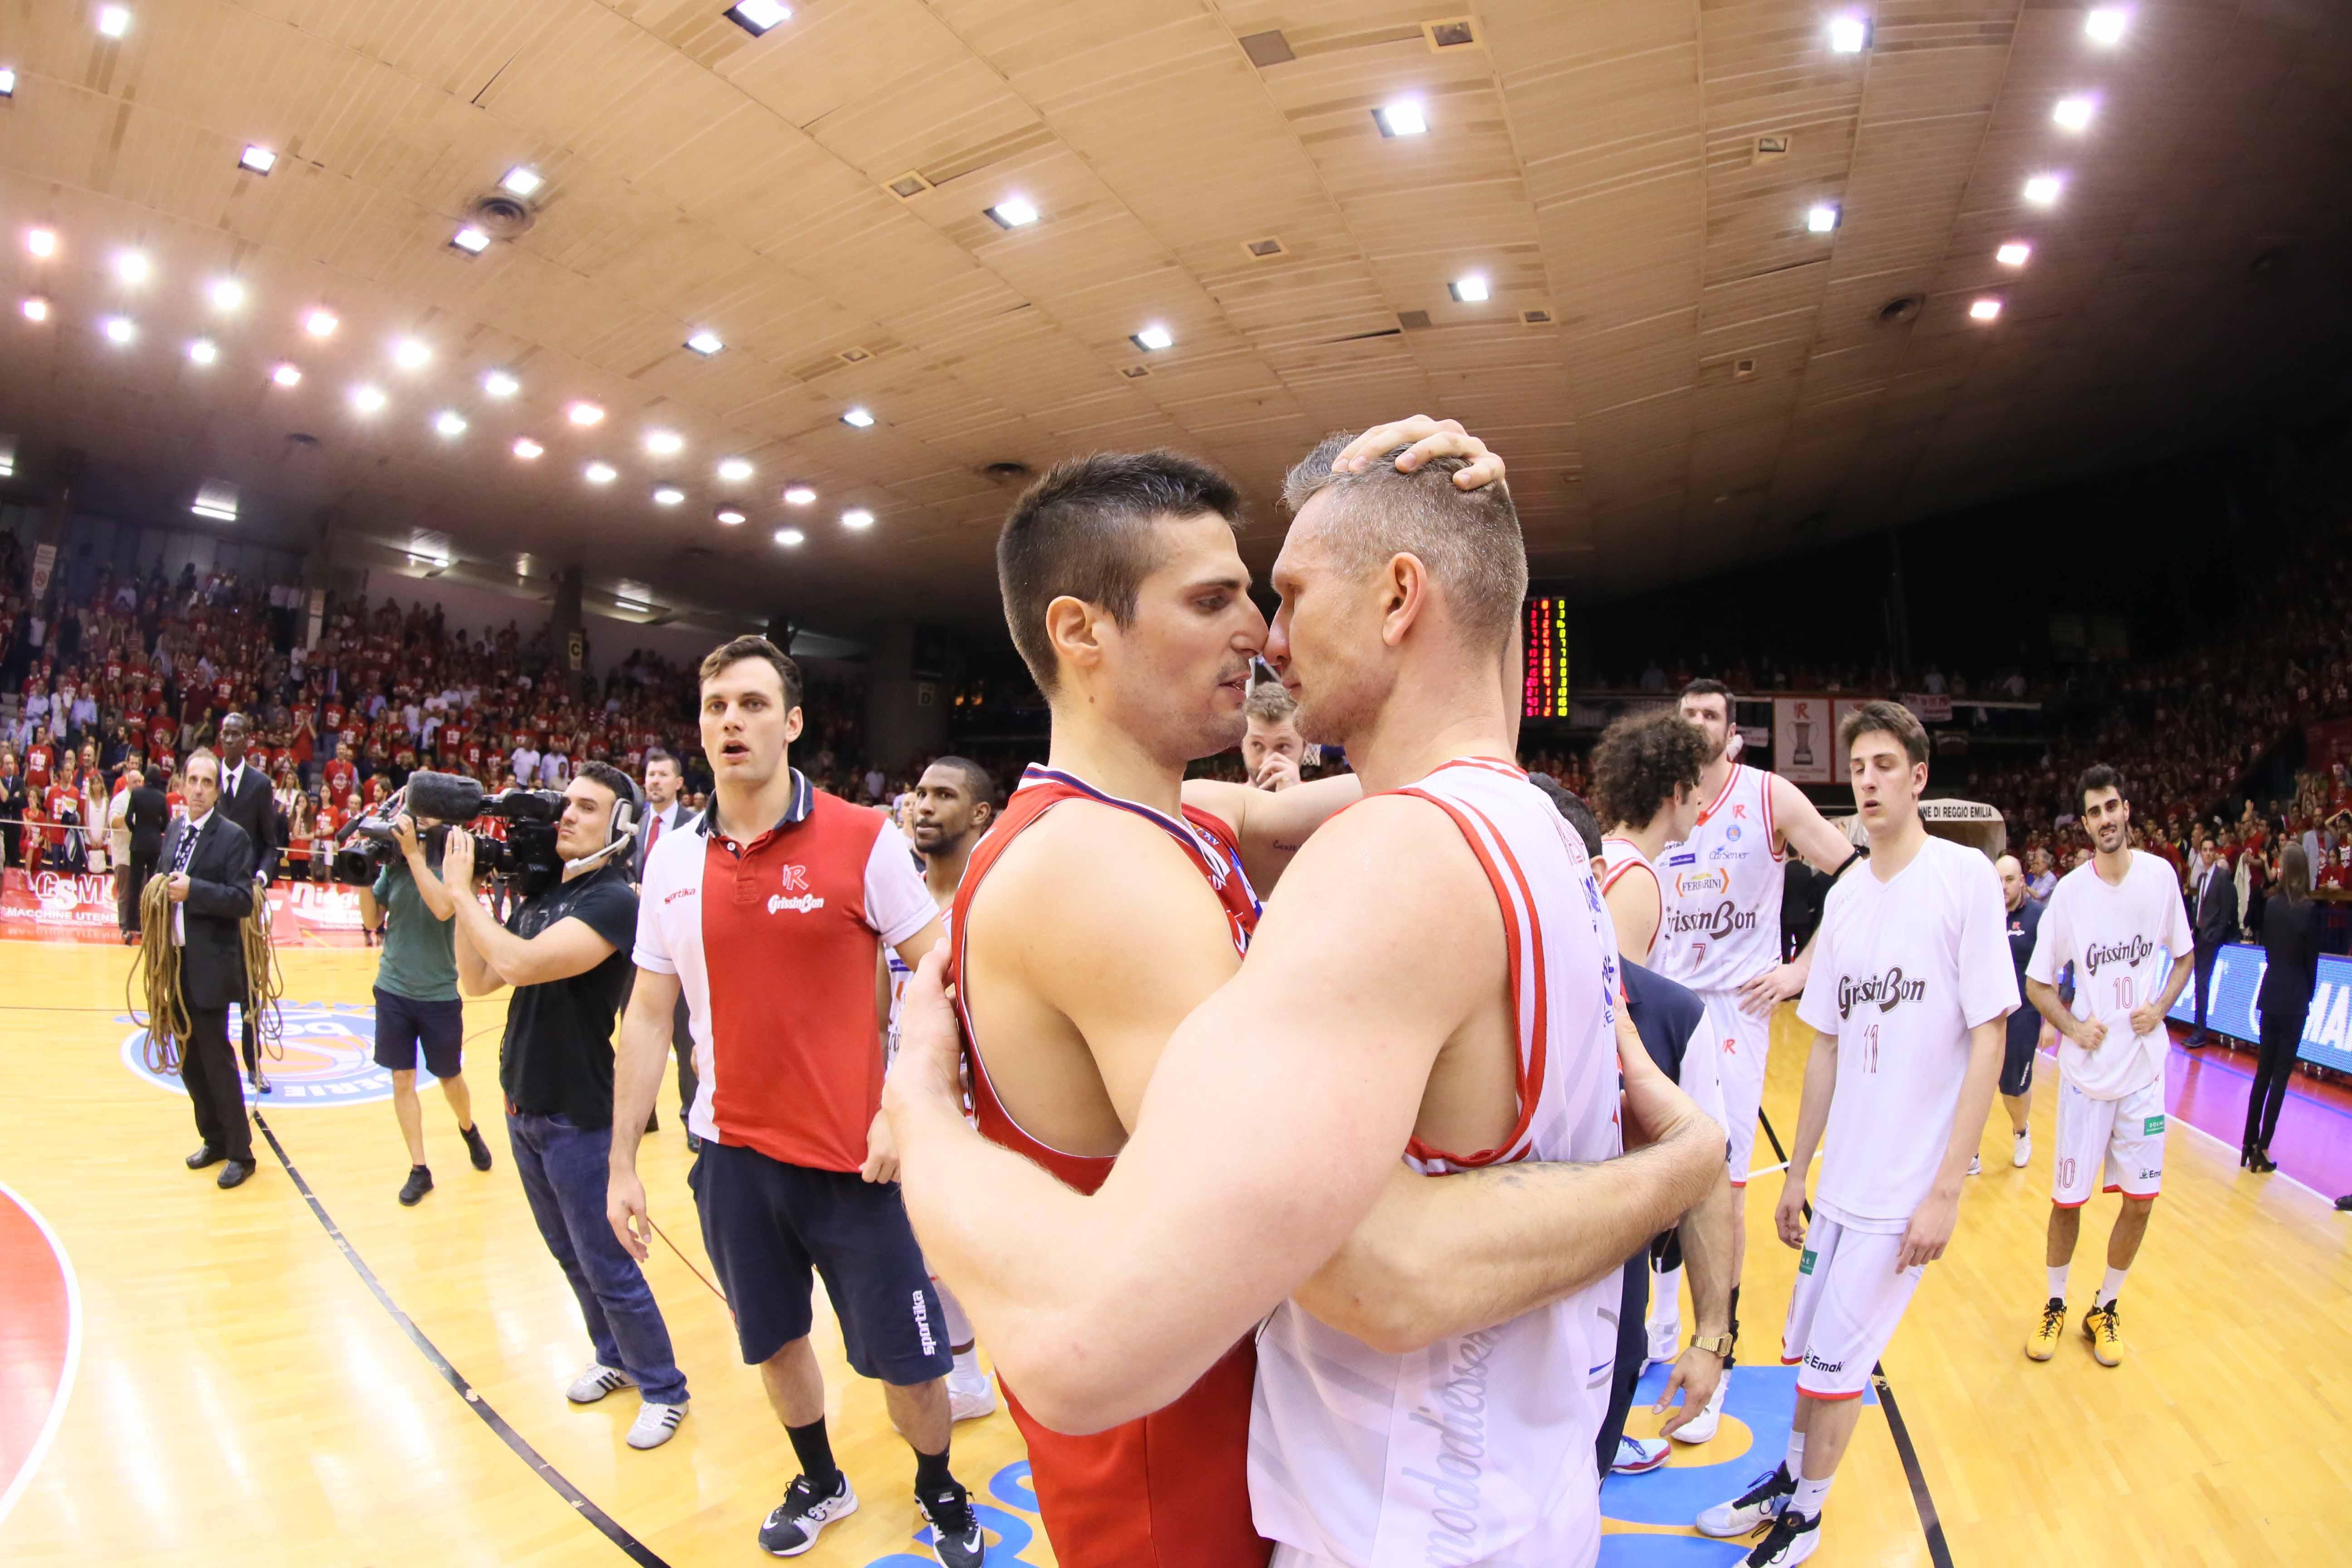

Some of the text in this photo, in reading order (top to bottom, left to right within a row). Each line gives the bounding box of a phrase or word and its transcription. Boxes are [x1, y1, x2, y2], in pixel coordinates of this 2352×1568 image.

[571, 642, 582, 657] C
[1934, 806, 1940, 818] DI
[1943, 806, 1968, 818] REGGIO
[1970, 806, 1992, 818] EMILIA
[6, 907, 119, 922] MACCHINE UTENS
[767, 893, 824, 915] GrissinBon
[1691, 943, 1706, 974] 7
[2112, 976, 2133, 1010] 10
[912, 1290, 936, 1356] sportika
